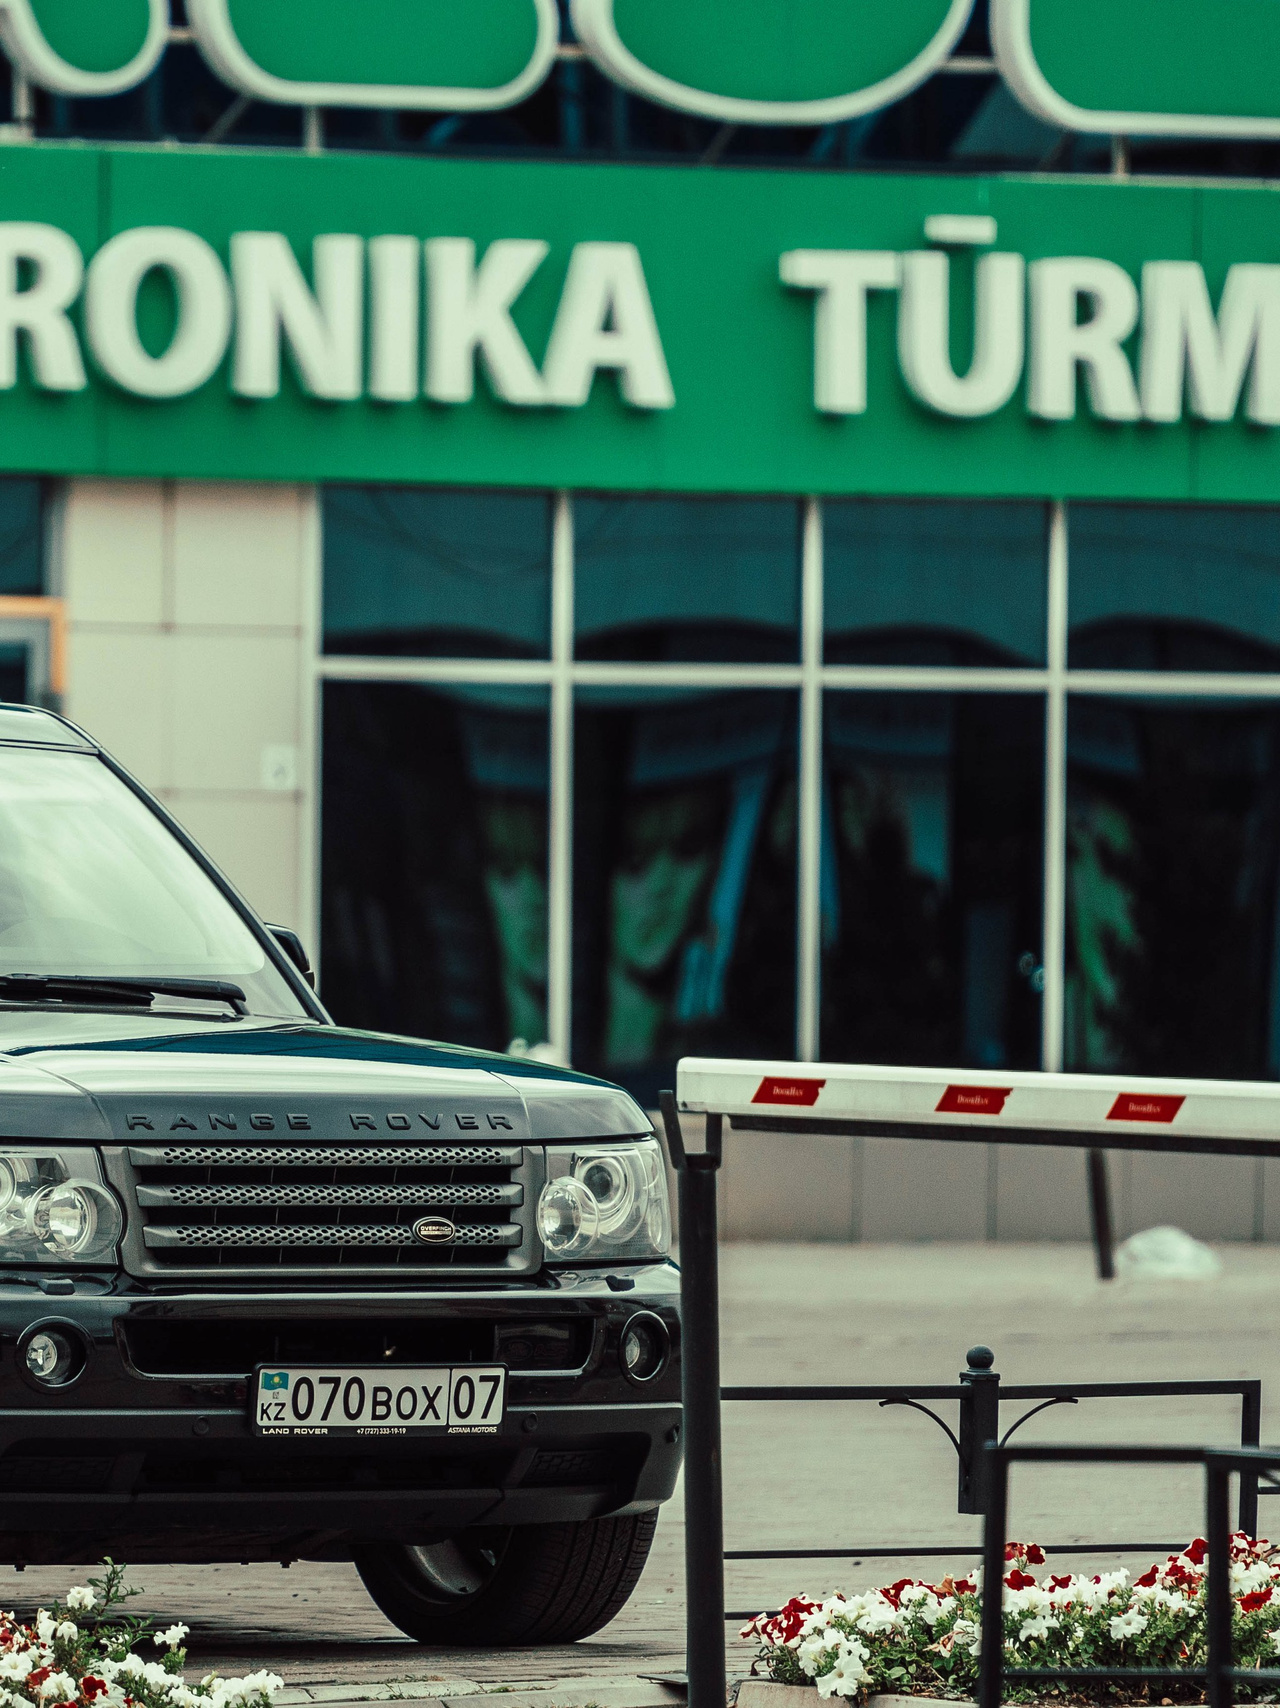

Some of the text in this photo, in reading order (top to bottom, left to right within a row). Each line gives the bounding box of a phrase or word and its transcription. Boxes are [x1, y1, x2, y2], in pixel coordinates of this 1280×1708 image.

[778, 213, 1280, 427] TŪRM
[125, 1112, 514, 1131] RANGE ROVER
[452, 1374, 502, 1420] 07
[260, 1402, 287, 1422] KZ
[262, 1427, 328, 1435] LAND ROVER
[470, 1426, 498, 1434] MOTORS
